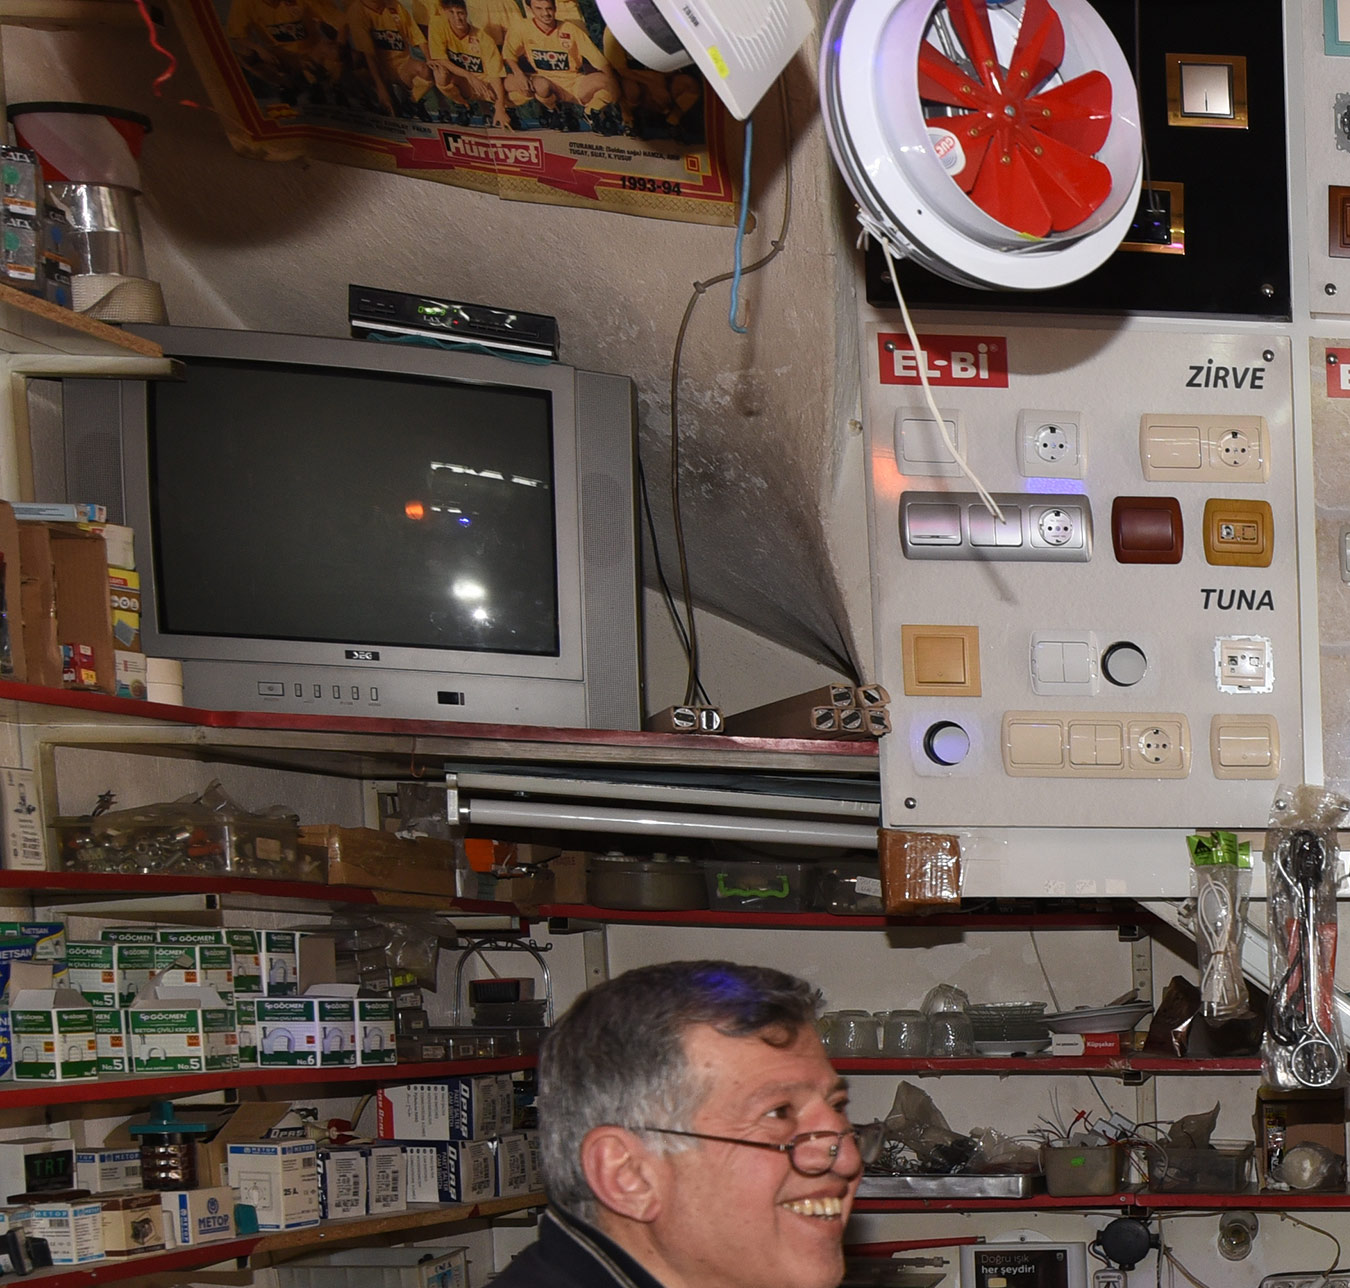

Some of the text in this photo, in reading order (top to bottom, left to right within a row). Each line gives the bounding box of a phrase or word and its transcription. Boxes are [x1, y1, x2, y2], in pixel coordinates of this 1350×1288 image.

[532, 49, 568, 63] SHOW
[448, 135, 539, 164] Hürriyet
[619, 175, 682, 196] 1993-94
[1185, 358, 1266, 390] ZİRVE
[1200, 588, 1276, 612] TUNA
[102, 1058, 123, 1071] No.5
[178, 1058, 200, 1070] No.5
[296, 1054, 315, 1066] No.6
[33, 1157, 66, 1176] TRT
[34, 1210, 69, 1218] METOP
[198, 1214, 230, 1230] METOP
[981, 1253, 1030, 1265] Doğru ışık
[981, 1264, 1036, 1275] her şeydir!
